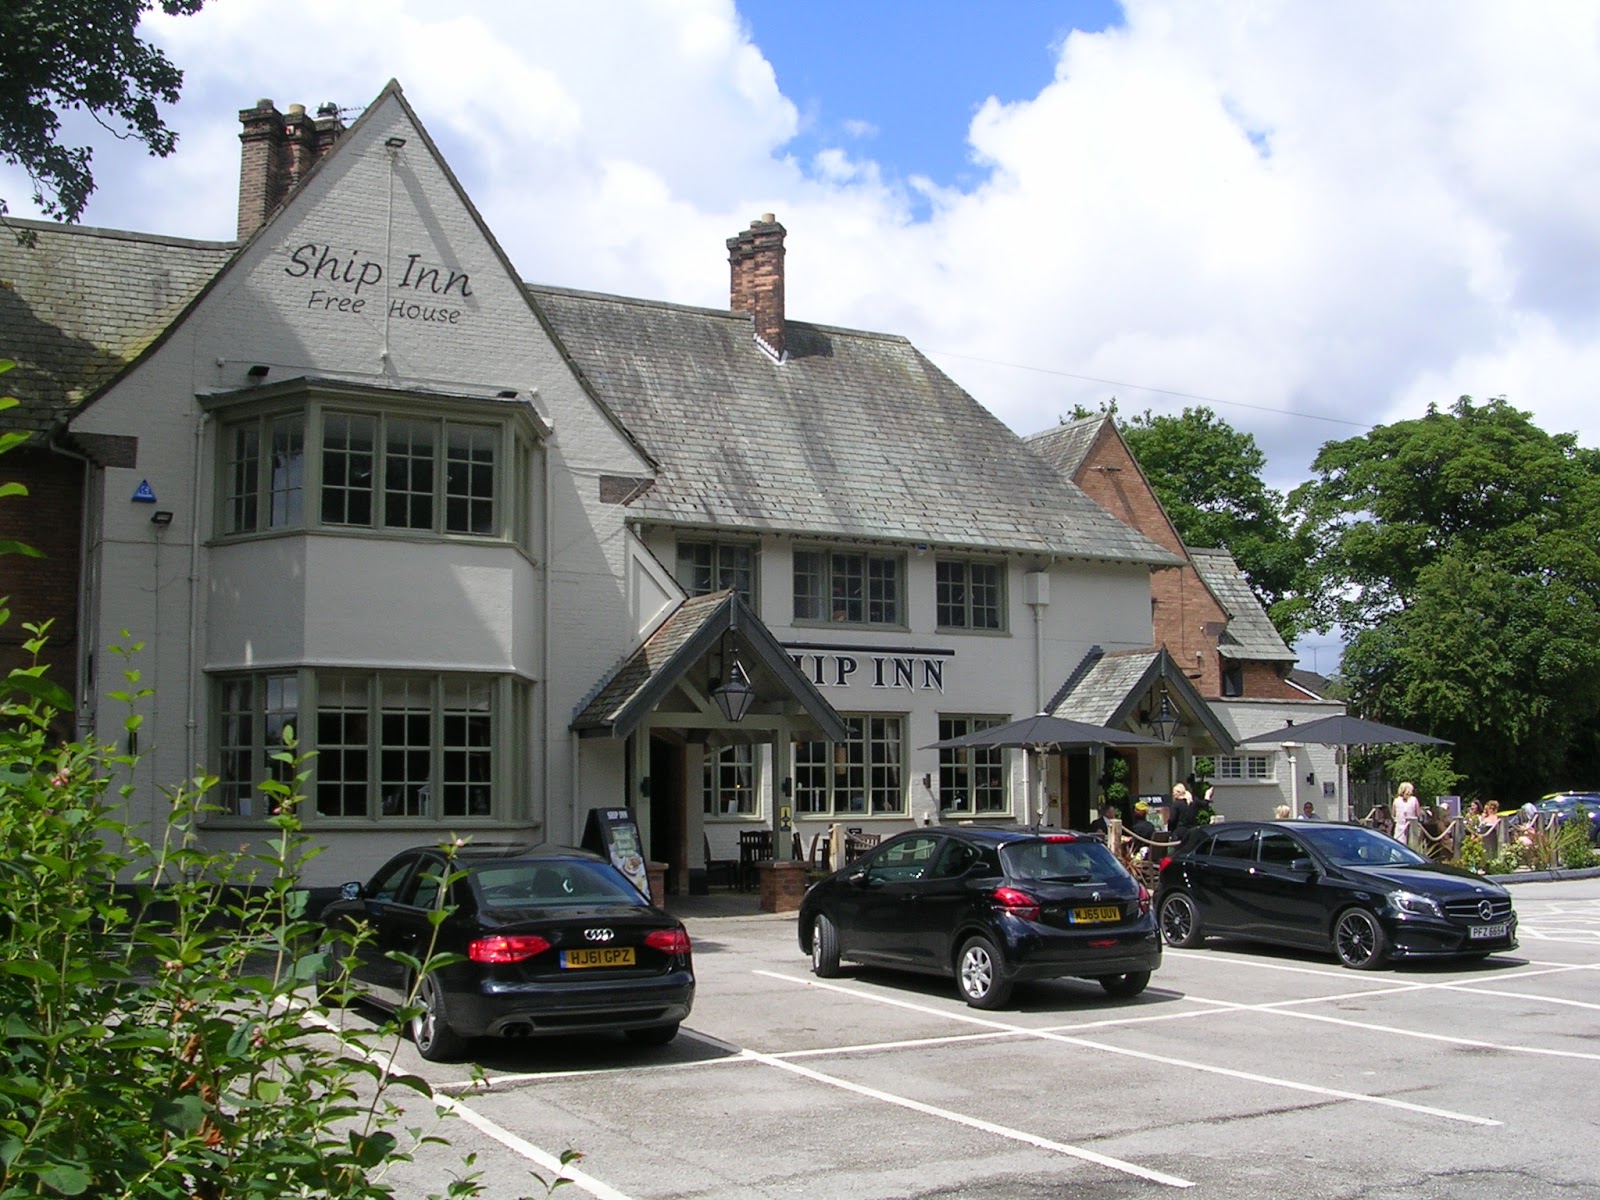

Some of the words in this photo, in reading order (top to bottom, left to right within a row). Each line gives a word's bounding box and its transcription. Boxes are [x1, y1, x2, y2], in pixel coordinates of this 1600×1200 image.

[284, 244, 382, 294] Ship
[399, 254, 472, 297] Inn
[307, 290, 366, 313] Free
[389, 299, 461, 324] House
[787, 653, 859, 687] IP
[870, 656, 947, 694] INN
[1473, 927, 1488, 937] PFZ
[571, 950, 602, 965] HJ61
[604, 949, 630, 963] GPZ
